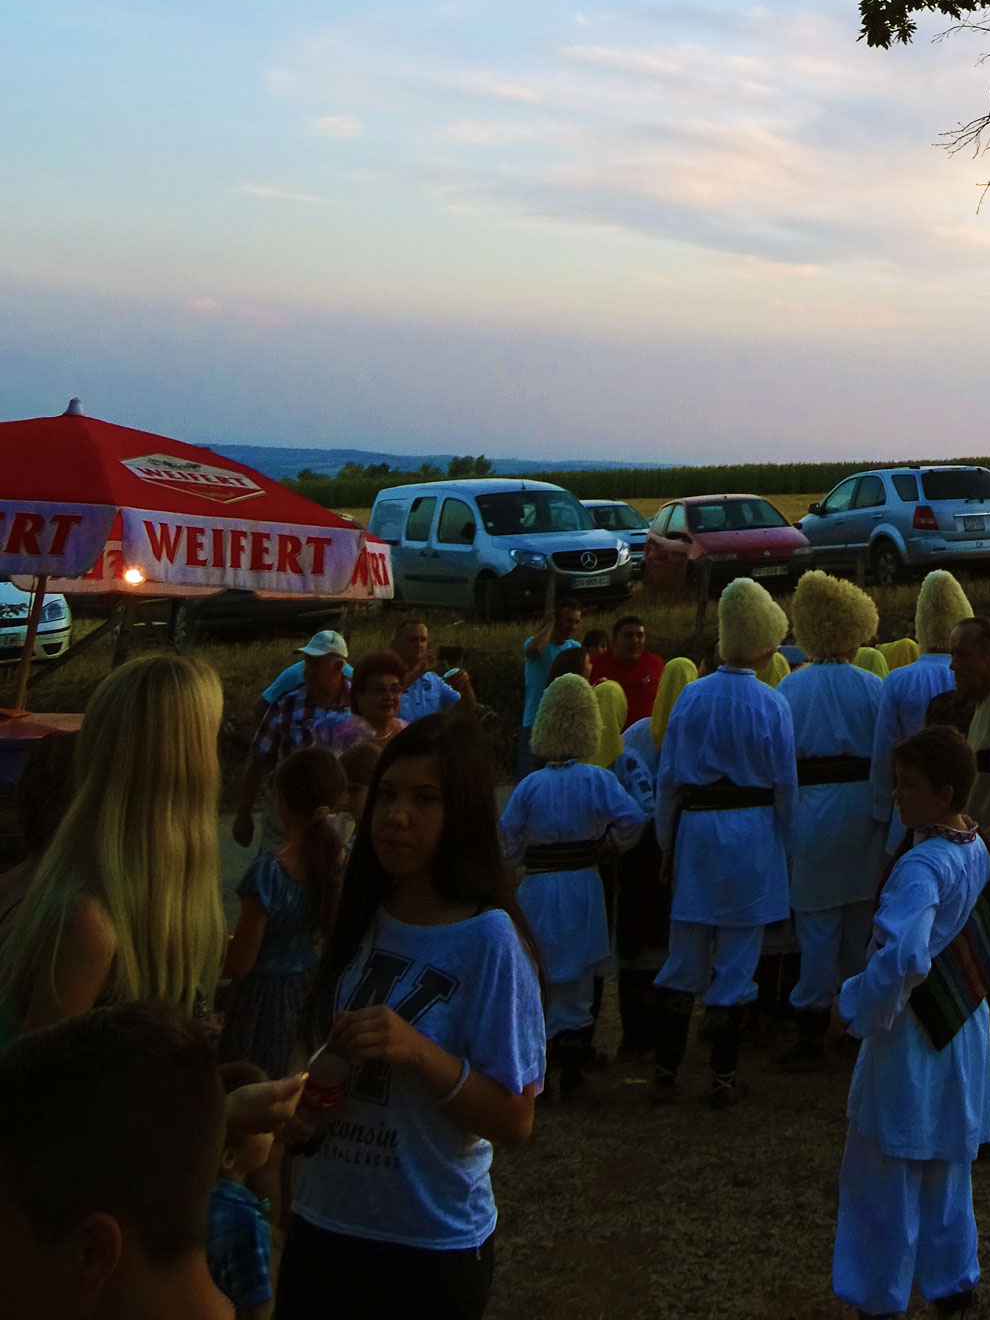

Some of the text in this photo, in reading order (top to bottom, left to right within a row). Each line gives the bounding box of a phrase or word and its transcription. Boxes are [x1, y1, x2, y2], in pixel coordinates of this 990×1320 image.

[136, 466, 248, 488] WEIFERT
[0, 511, 83, 556] RT
[143, 520, 333, 576] WEIFERT
[328, 1119, 399, 1148] consin
